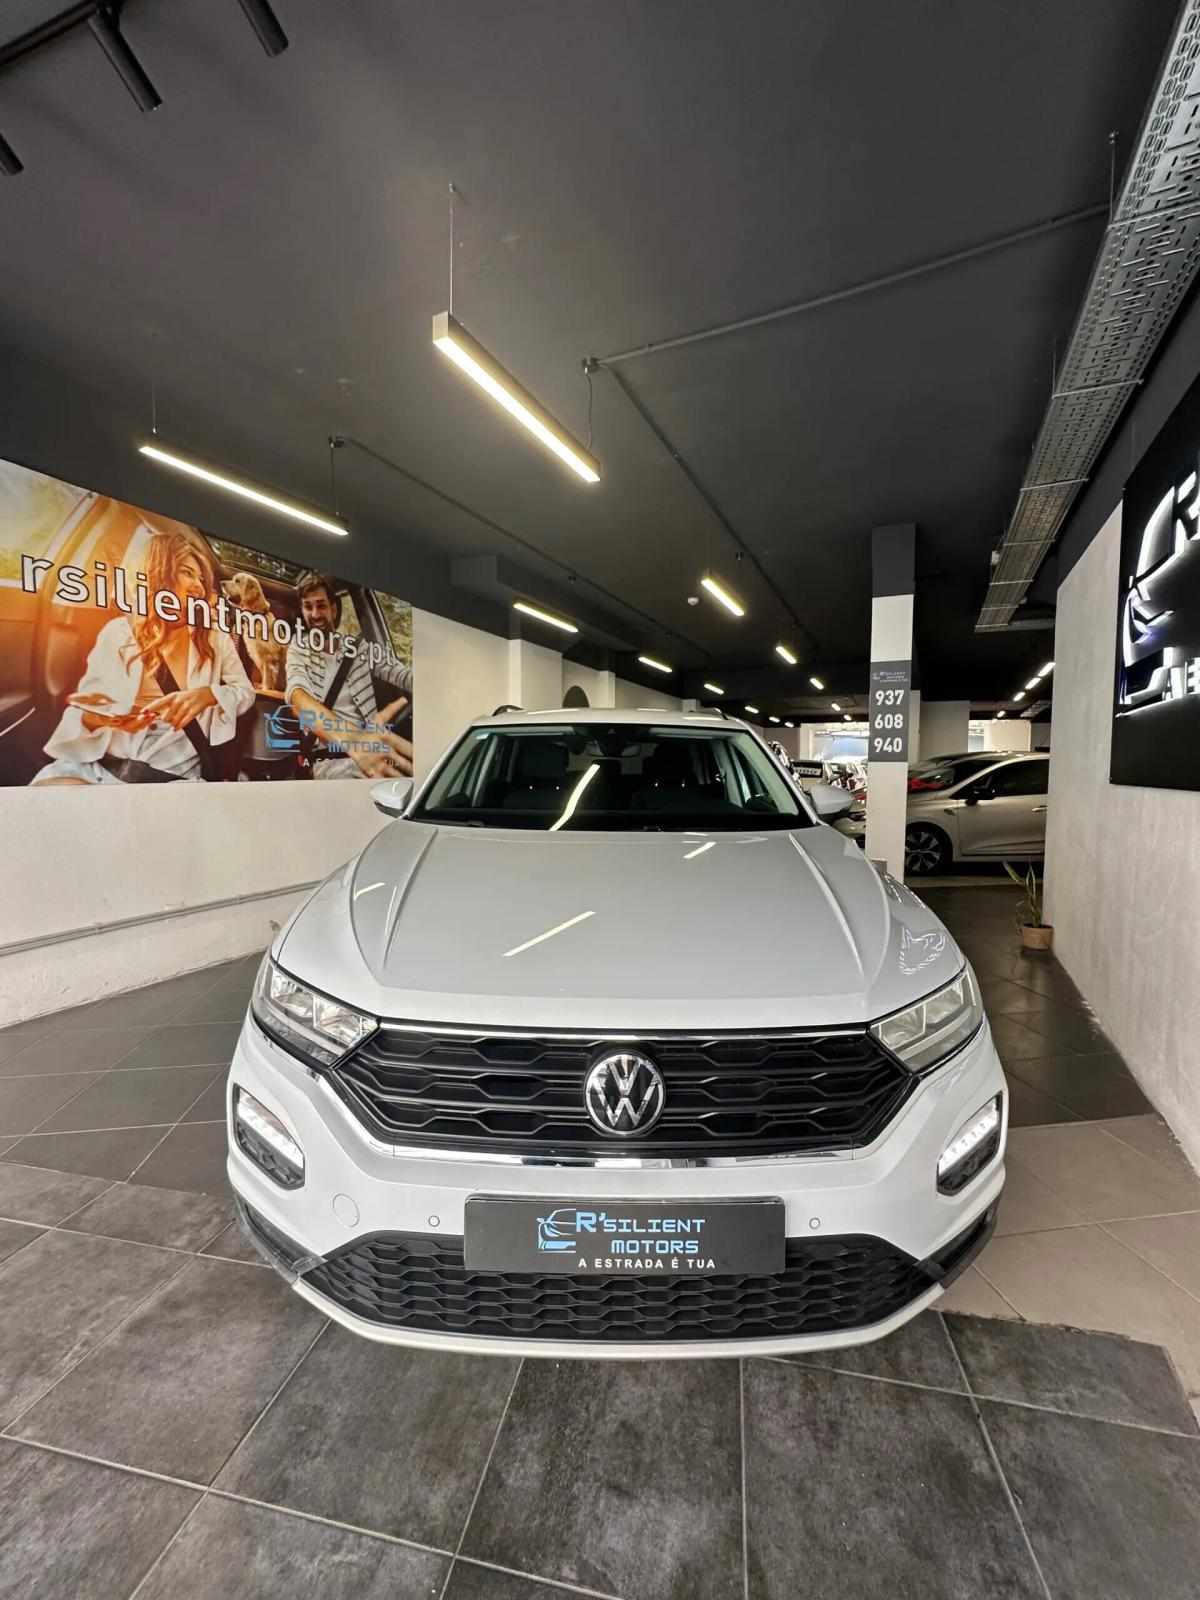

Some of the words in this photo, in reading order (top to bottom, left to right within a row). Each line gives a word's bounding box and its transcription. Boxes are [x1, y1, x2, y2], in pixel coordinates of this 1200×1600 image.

[21, 554, 394, 669] rsilientmotors.pt
[875, 690, 904, 706] 937
[874, 714, 903, 729] 608
[327, 740, 391, 753] MOTORS
[873, 737, 902, 753] 940
[575, 1211, 705, 1233] R'SILIENT
[610, 1239, 699, 1254] MOTORS
[578, 1257, 587, 1269] A
[594, 1257, 664, 1270] ESTRADA
[671, 1256, 679, 1269] É
[687, 1257, 716, 1270] TUA
